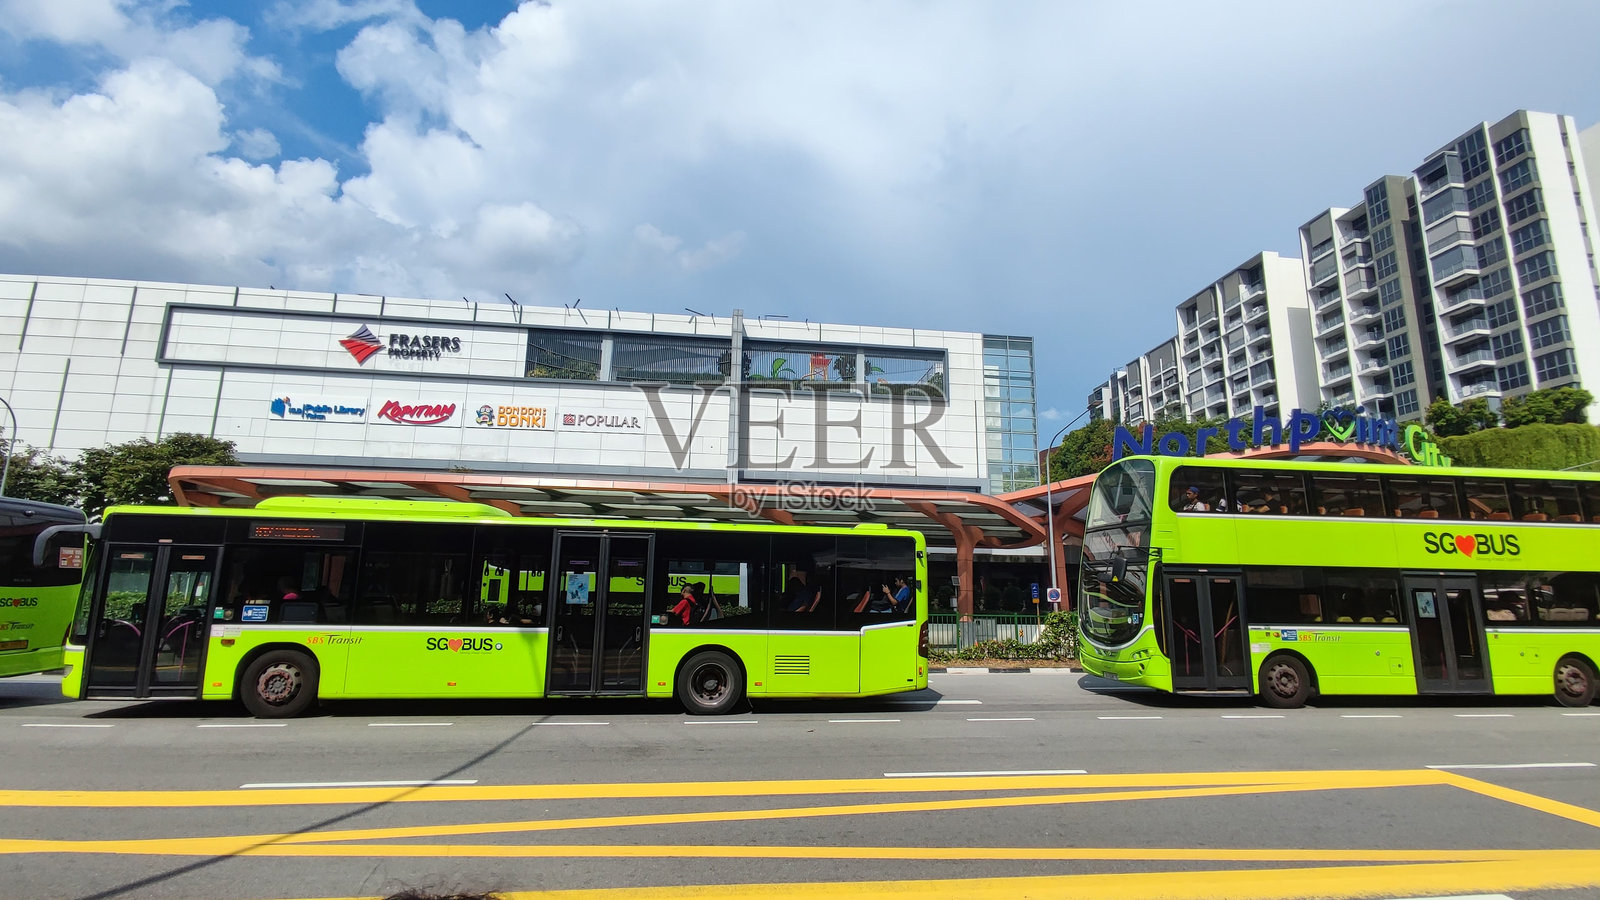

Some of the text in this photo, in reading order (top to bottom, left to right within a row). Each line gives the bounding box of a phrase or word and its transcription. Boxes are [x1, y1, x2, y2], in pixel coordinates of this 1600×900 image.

[389, 333, 461, 353] FRASERS
[388, 347, 441, 361] PROPERTY
[333, 404, 366, 417] Library
[498, 405, 519, 415] DON
[577, 413, 642, 429] POPULAR
[306, 634, 364, 645] SBS Transit
[1298, 633, 1313, 642] SBS
[1311, 632, 1342, 642] Transit
